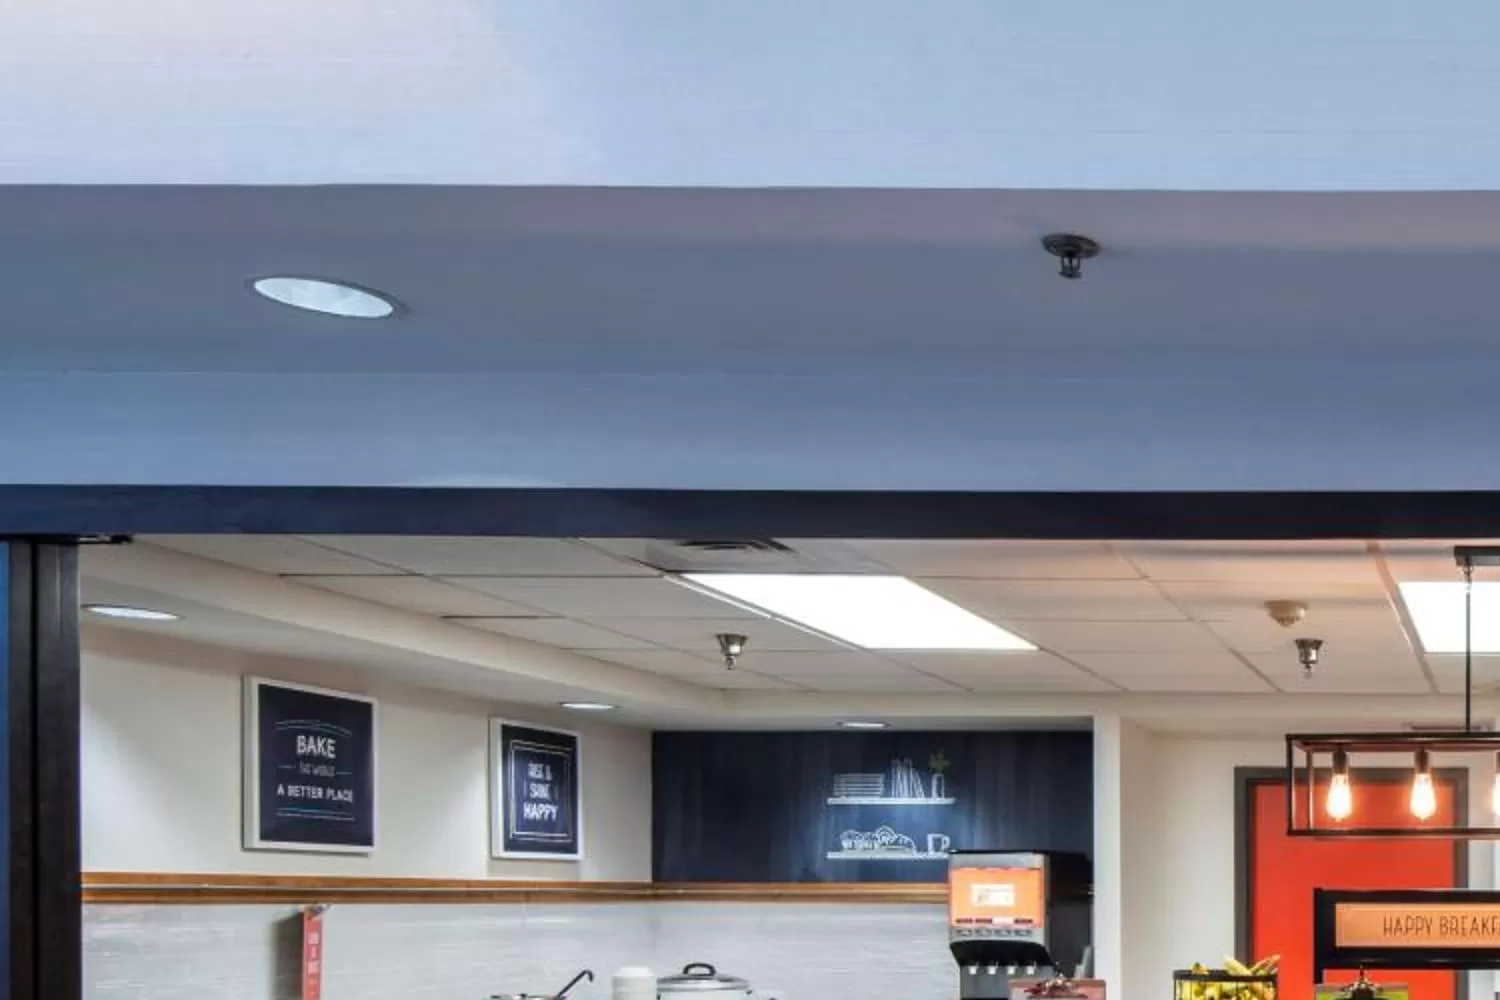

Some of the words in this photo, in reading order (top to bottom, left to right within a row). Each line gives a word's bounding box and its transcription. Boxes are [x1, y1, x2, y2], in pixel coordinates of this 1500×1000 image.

[296, 735, 336, 759] BAKE
[277, 783, 285, 796] A
[287, 785, 323, 799] BETTER
[326, 787, 353, 802] PLACE
[523, 802, 558, 820] HAPPY
[1383, 915, 1433, 937] HAPPY
